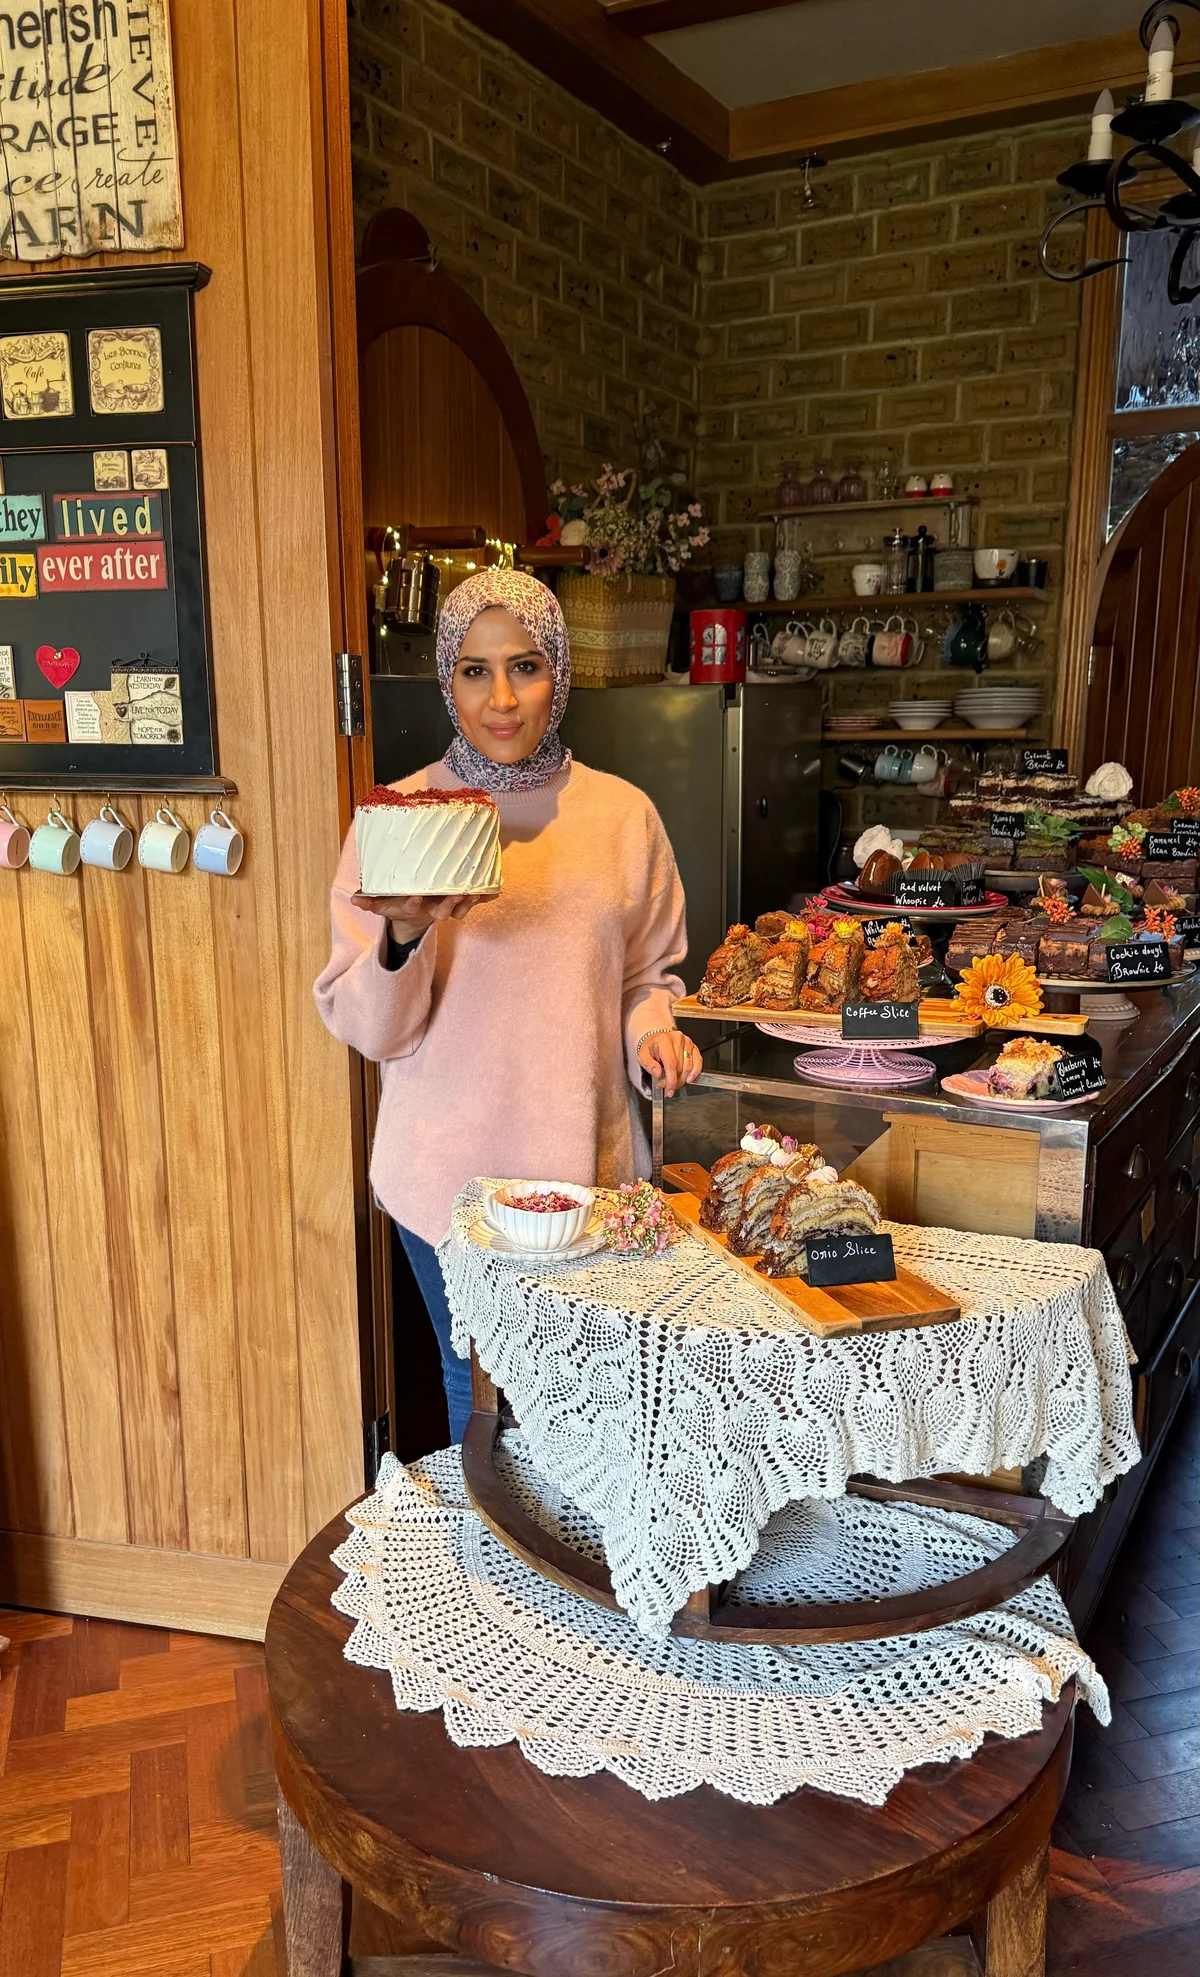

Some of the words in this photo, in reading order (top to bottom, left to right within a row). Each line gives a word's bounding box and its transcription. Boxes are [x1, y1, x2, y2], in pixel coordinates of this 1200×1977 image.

[127, 0, 158, 148] IEVE
[24, 365, 45, 384] Café
[61, 496, 152, 538] lived
[42, 554, 94, 582] ever
[100, 547, 160, 581] after
[154, 707, 179, 715] TODAY
[900, 881, 916, 892] Red
[918, 881, 942, 892] velvet
[896, 892, 927, 907] Whoopie
[1110, 947, 1139, 960] Cookie
[1111, 961, 1150, 980] Brownie
[846, 1006, 878, 1019] Coffee
[880, 1005, 910, 1019] Slice
[843, 1241, 876, 1258] Slice
